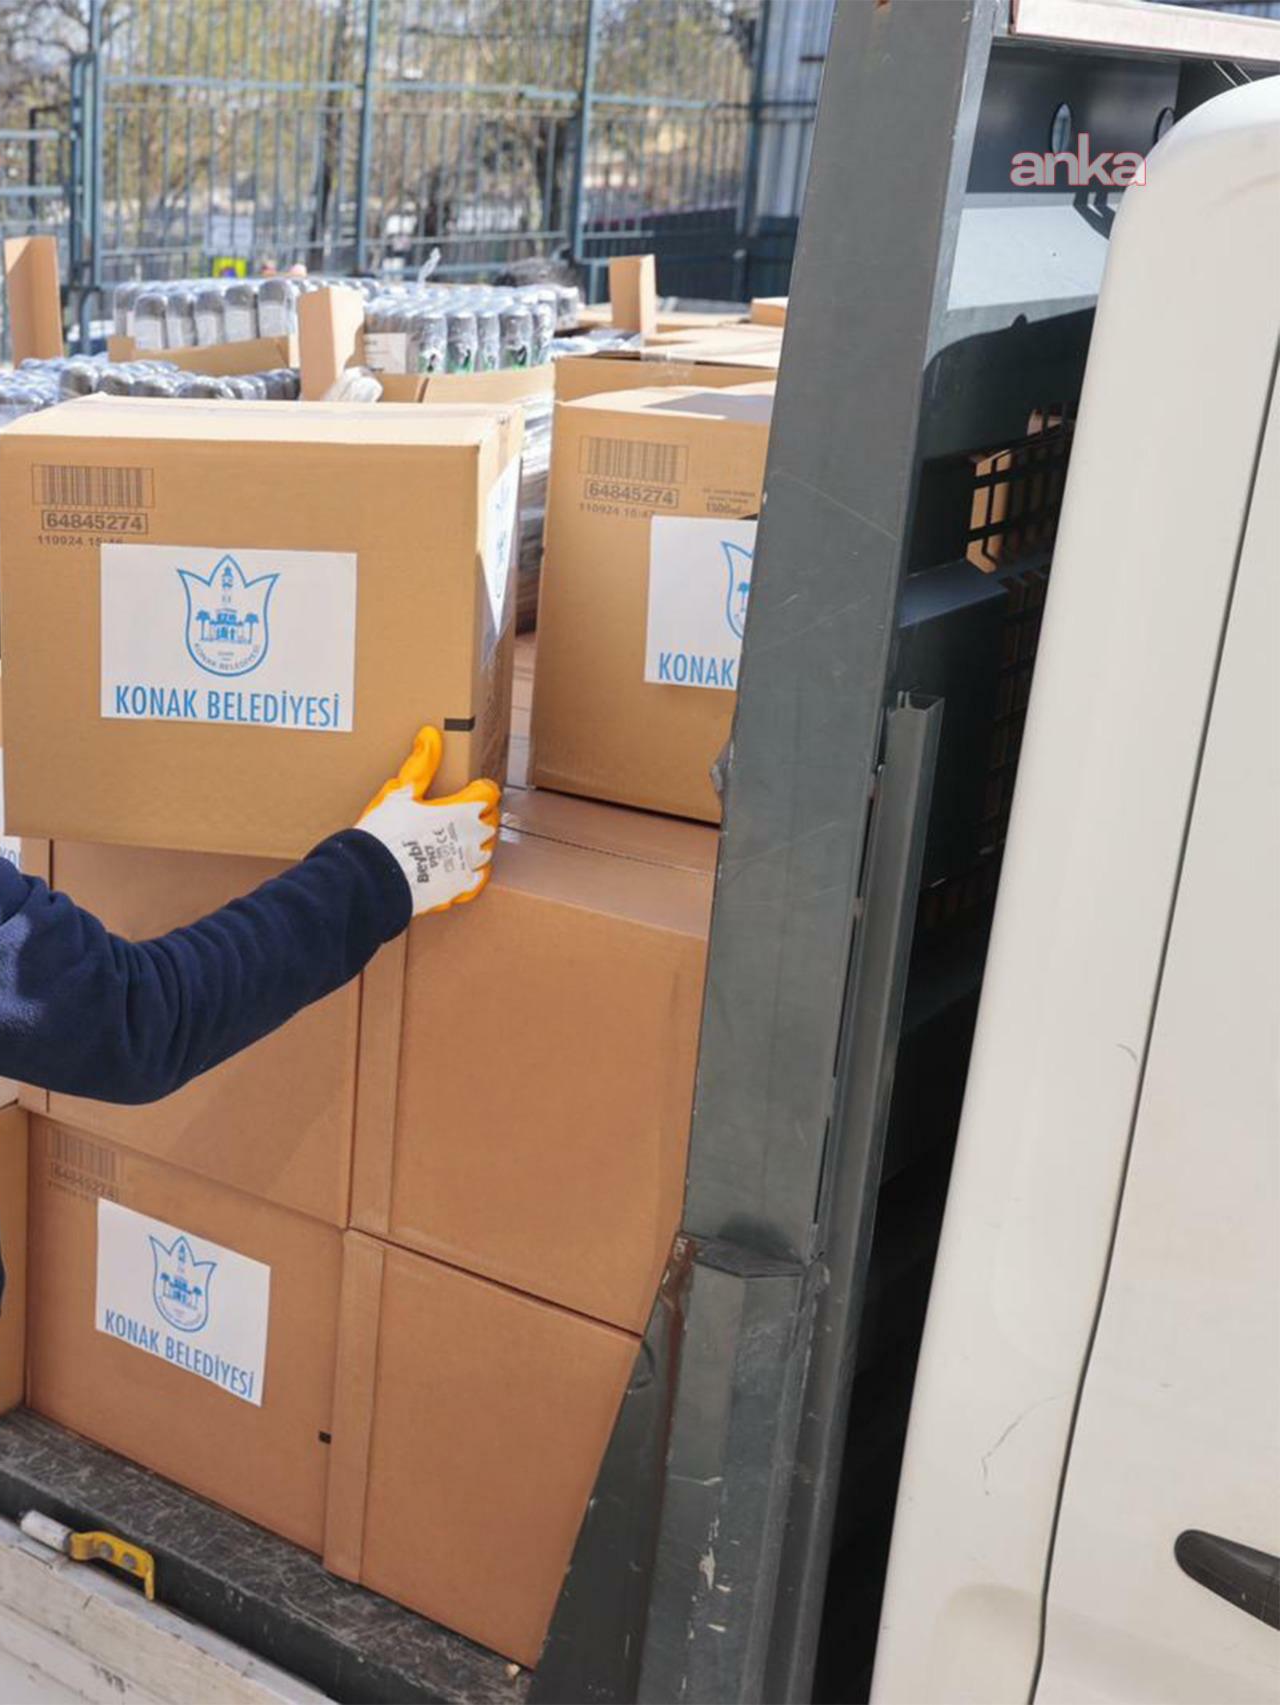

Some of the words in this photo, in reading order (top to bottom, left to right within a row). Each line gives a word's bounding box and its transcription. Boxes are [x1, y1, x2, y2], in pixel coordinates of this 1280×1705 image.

[589, 483, 674, 505] 64845274
[46, 513, 143, 531] 64845274
[659, 652, 735, 687] KONAK
[115, 685, 198, 719] KONAK
[207, 687, 340, 728] BELEDİYESİ
[104, 1308, 160, 1353] KONAK
[164, 1336, 255, 1399] BELEDİYESİ
